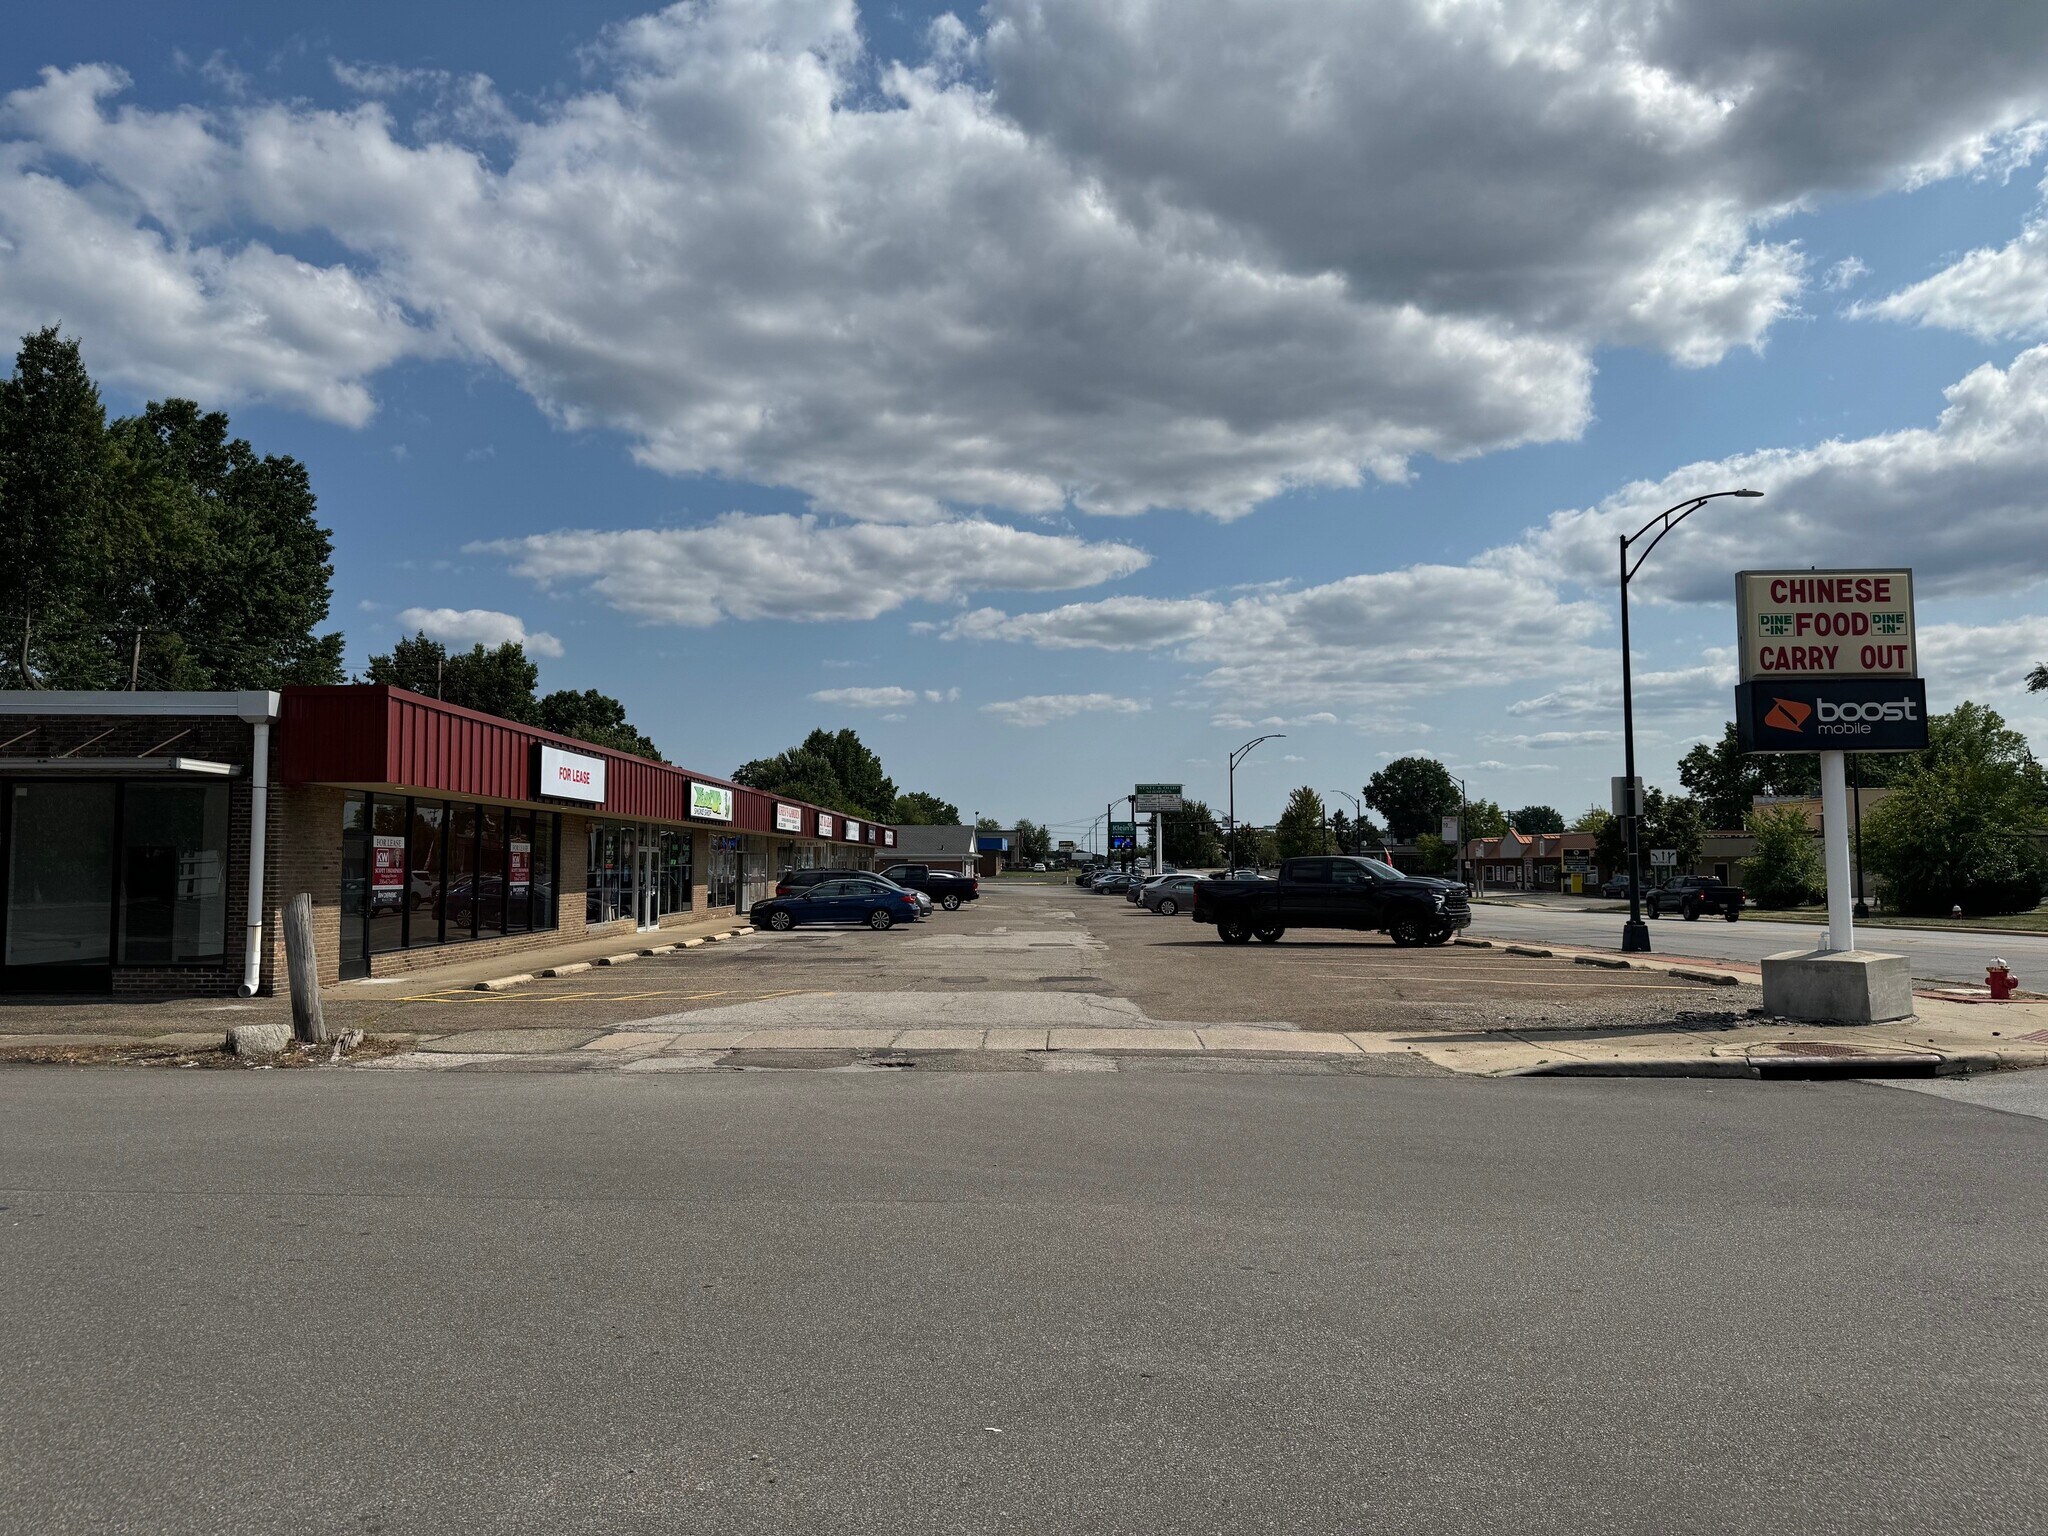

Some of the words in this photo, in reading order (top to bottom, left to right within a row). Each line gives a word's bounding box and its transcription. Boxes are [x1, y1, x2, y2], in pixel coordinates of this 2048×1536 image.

[1770, 578, 1891, 604] CHINESE
[1760, 615, 1793, 625] DINE
[1796, 612, 1869, 637] FOOD
[1872, 613, 1905, 624] DINE
[1760, 646, 1840, 671] CARRY
[1860, 645, 1908, 670] OUT
[1816, 697, 1918, 722] boost
[1818, 723, 1872, 735] mobile
[559, 766, 571, 781] FOR
[572, 769, 590, 785] LEASE
[376, 838, 387, 847] FOR
[387, 839, 402, 847] LEASE
